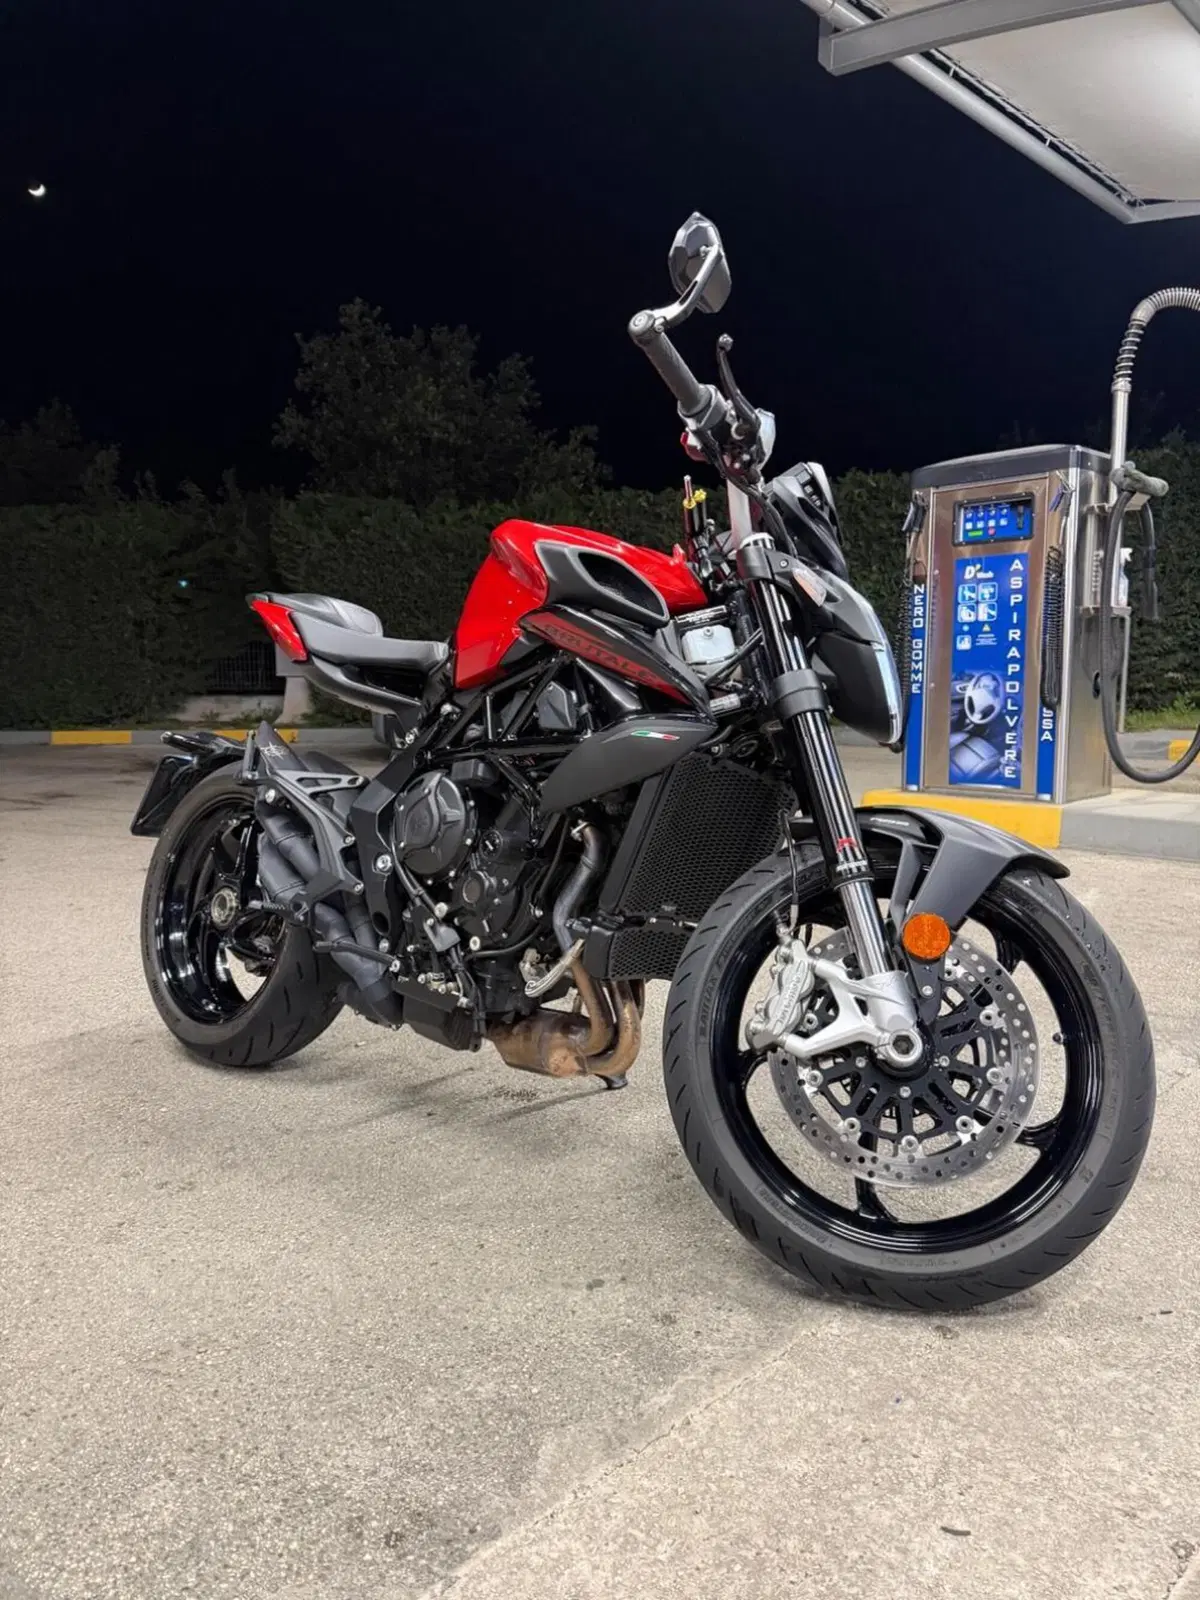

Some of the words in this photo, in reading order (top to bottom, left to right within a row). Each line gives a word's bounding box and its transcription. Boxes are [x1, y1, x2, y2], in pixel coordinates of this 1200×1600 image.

[912, 583, 925, 629] NERO
[910, 638, 923, 694] GOMME
[1004, 559, 1024, 778] ASPIRAPOLVERE
